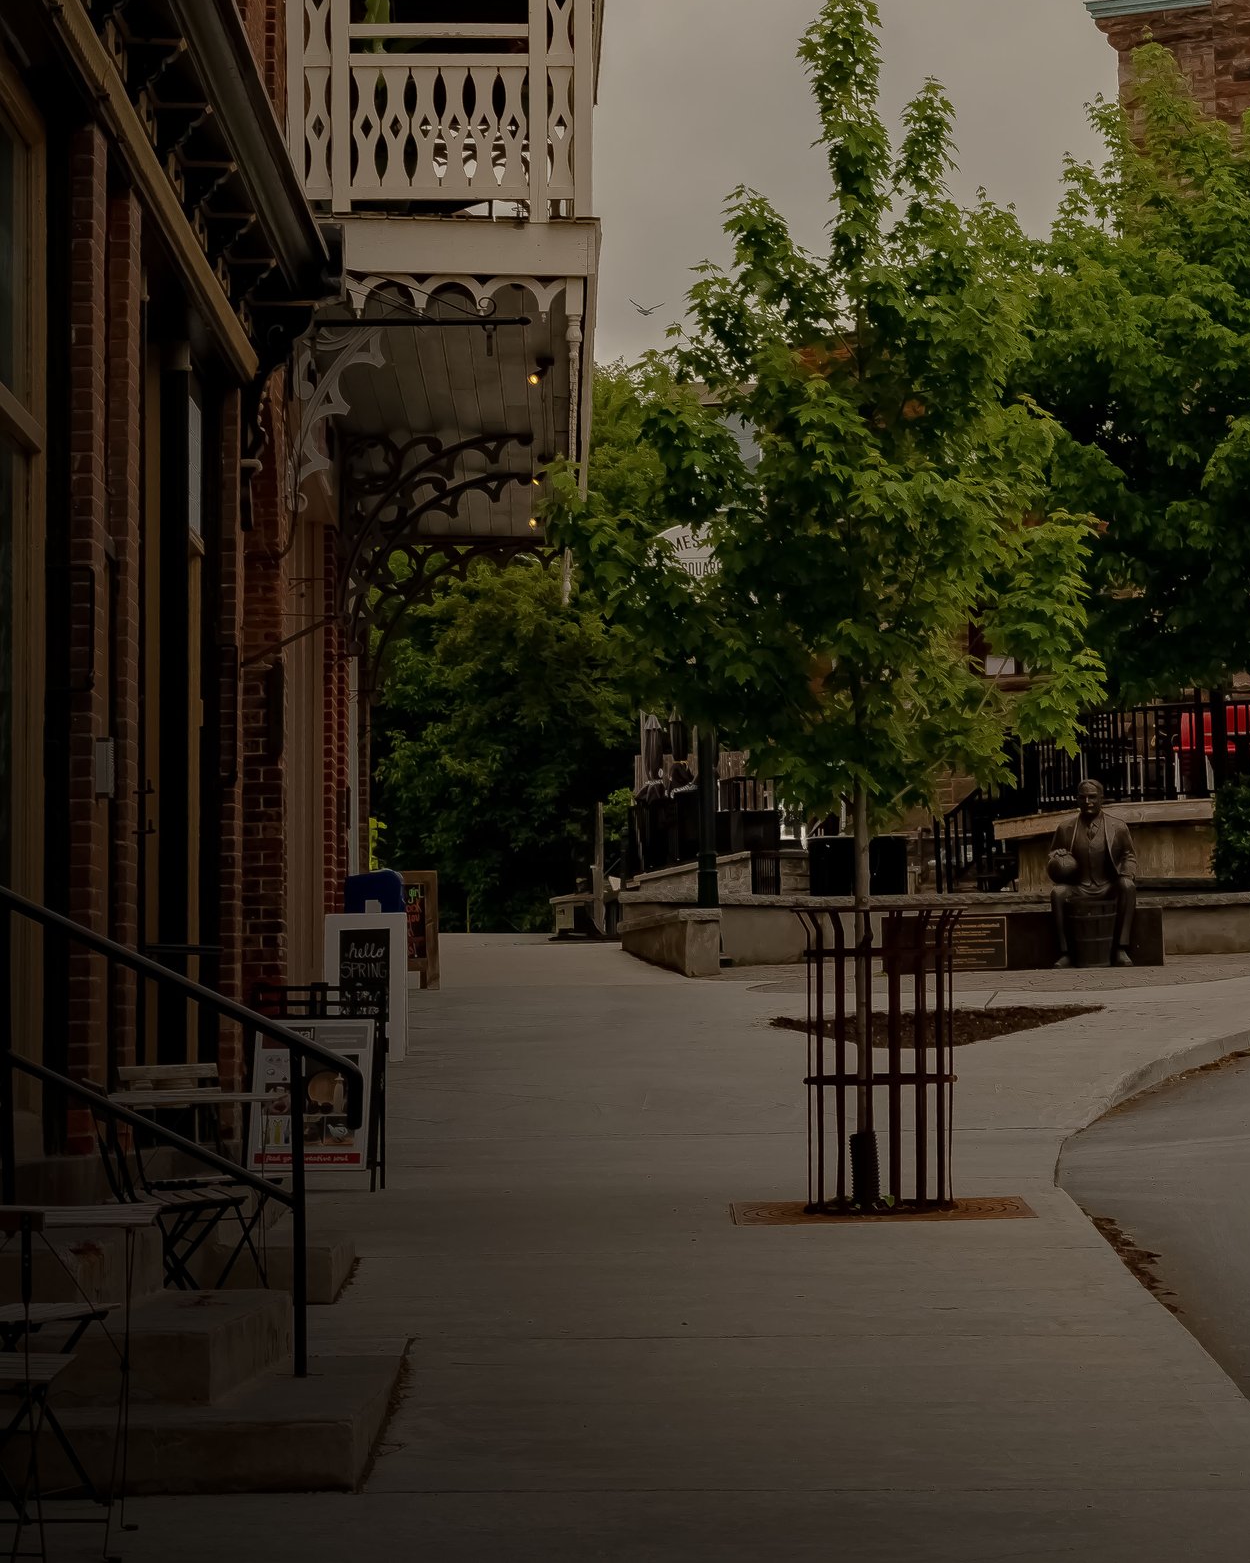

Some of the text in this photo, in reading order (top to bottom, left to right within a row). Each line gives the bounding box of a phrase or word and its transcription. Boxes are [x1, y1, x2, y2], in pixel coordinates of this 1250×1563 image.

[673, 533, 700, 551] MES
[349, 942, 386, 959] hello
[340, 961, 387, 979] SPRING
